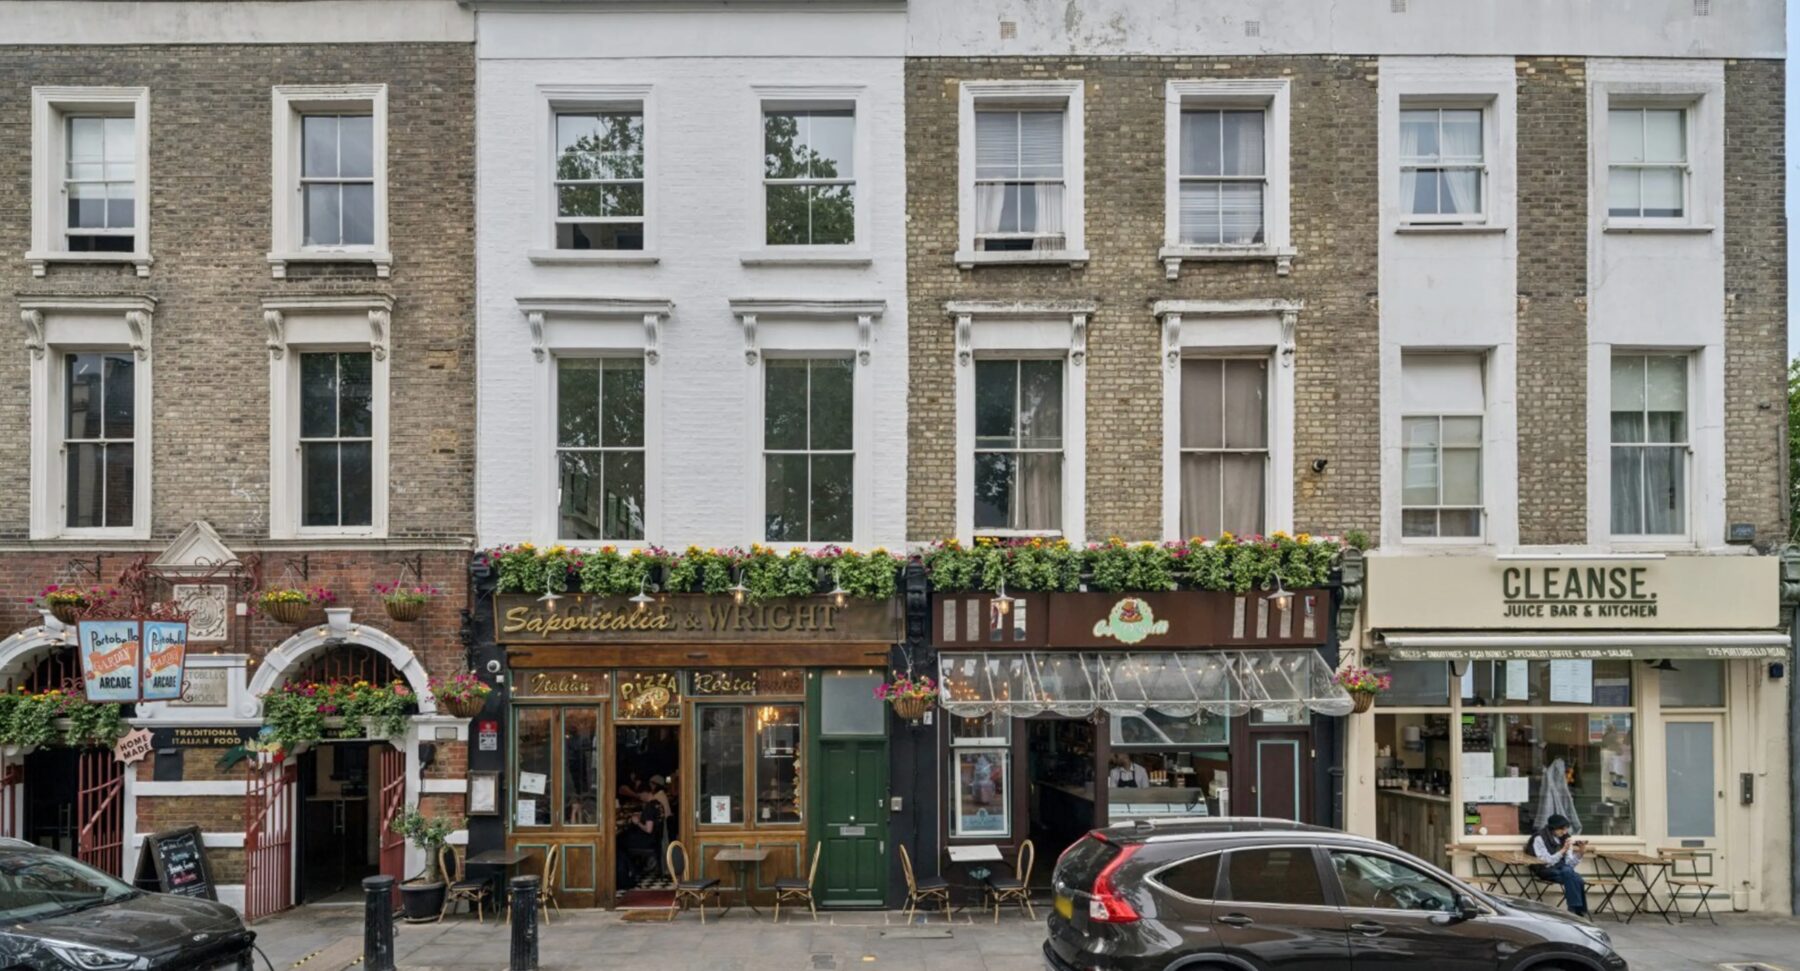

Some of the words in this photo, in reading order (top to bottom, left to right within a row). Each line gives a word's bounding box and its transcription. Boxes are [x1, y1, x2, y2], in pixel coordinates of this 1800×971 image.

[705, 603, 838, 631] WRIGHT
[1503, 605, 1544, 617] JUICE
[1550, 605, 1578, 617] BAR
[1583, 605, 1593, 617] &
[1599, 605, 1658, 617] KITCHEN
[503, 606, 669, 638] Saporitalia
[91, 628, 139, 652] Portobello
[100, 677, 132, 689] ARCADE
[153, 676, 177, 688] ARCADE
[531, 673, 592, 693] Italian
[120, 734, 148, 751] HOME
[172, 737, 209, 745] ITALIAN
[123, 743, 150, 760] MADE
